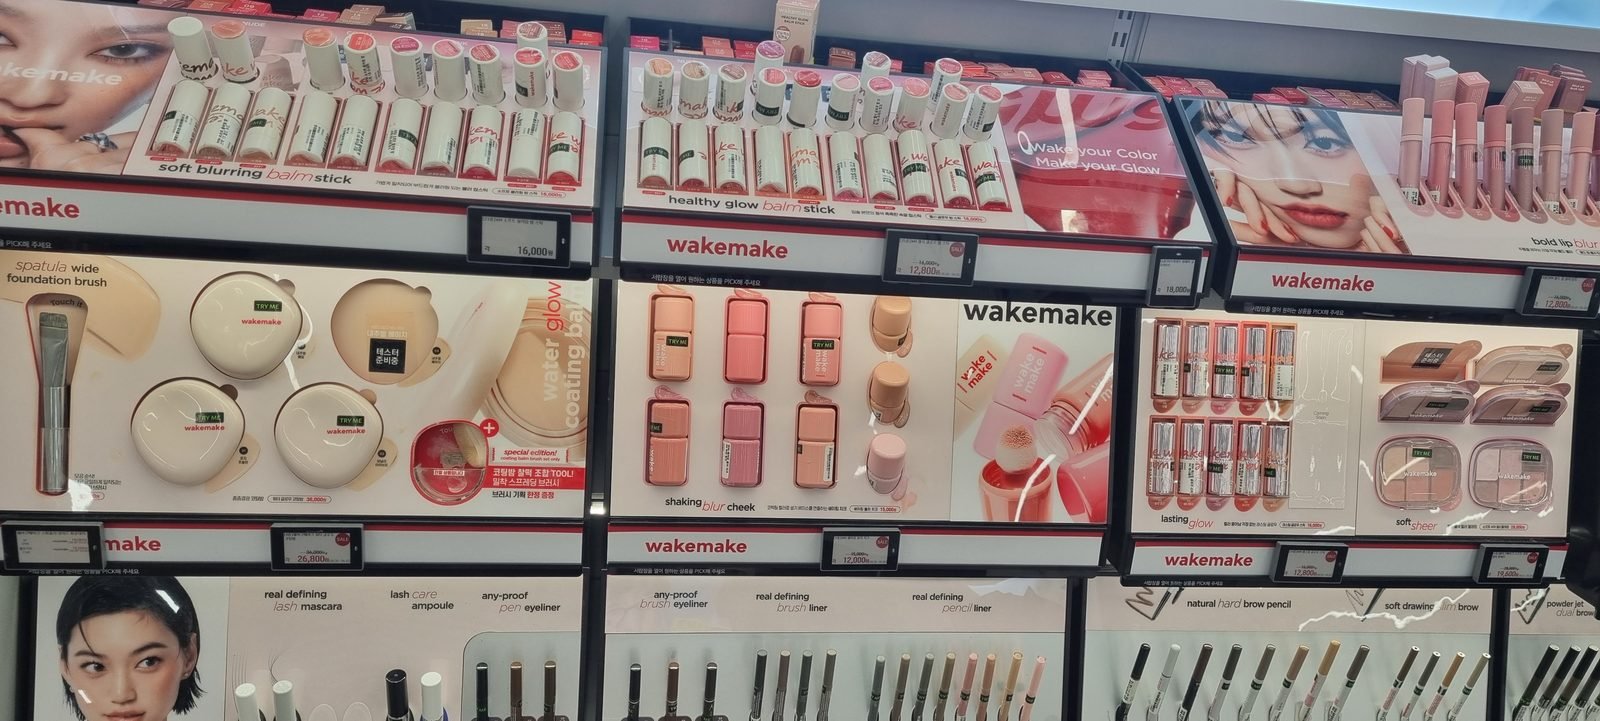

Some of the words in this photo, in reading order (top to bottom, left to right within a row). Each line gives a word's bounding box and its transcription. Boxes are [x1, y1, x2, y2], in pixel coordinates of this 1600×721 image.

[1077, 148, 1112, 158] your
[1117, 148, 1158, 161] Color
[1036, 157, 1076, 168] Make
[1081, 161, 1117, 172] your
[1121, 162, 1160, 175] Glow
[158, 162, 192, 174] soft
[196, 164, 263, 180] blurring
[266, 168, 313, 182] balm
[314, 172, 352, 185] stick
[668, 195, 720, 209] healthy
[725, 198, 759, 211] glow
[762, 200, 802, 213] balm
[803, 203, 836, 215] stick
[667, 236, 788, 259] wakemake
[1531, 237, 1558, 246] bold
[1558, 238, 1573, 248] lip
[1574, 237, 1598, 249] blur
[15, 259, 67, 273] spatula
[71, 263, 100, 274] wide
[7, 273, 71, 286] foundation
[74, 276, 108, 288] brush
[1271, 271, 1375, 292] wakemake
[542, 281, 564, 332] glow
[963, 300, 1113, 327] wakemake
[241, 318, 282, 326] wakemake
[668, 338, 679, 346] TRY
[376, 347, 399, 357] 테스터
[375, 356, 399, 365] 준비중
[543, 337, 560, 402] water
[967, 361, 993, 389] make
[1013, 352, 1035, 389] wake
[1025, 357, 1045, 394] make
[564, 344, 586, 430] coating
[184, 424, 225, 432] wakemake
[503, 449, 530, 457] special
[530, 449, 558, 457] edition!
[493, 467, 516, 477] 코팅밤
[517, 468, 532, 477] 찰떡
[534, 468, 549, 477] 조합
[551, 470, 574, 478] TOOL!
[492, 478, 507, 486] 밀착
[508, 479, 537, 487] 스프레딩
[538, 479, 560, 487] 브러시
[492, 490, 512, 499] 브러시
[513, 491, 526, 499] 기획
[527, 491, 540, 499] 한정
[541, 491, 555, 499] 증정
[665, 497, 702, 508] shaking
[702, 500, 725, 512] blur
[727, 503, 756, 512] cheek
[1161, 514, 1189, 524] lasting
[1188, 519, 1214, 530] glow
[1396, 517, 1411, 526] soft
[1411, 520, 1438, 531] sheer
[645, 539, 747, 554] wakemake
[1165, 552, 1253, 567] wakemake
[264, 590, 283, 599] real
[286, 590, 327, 602] defining
[390, 590, 410, 599] lash
[412, 590, 437, 599] care
[482, 590, 528, 602] any-proof
[653, 590, 698, 600] any-proof
[756, 592, 773, 601] real
[774, 592, 809, 602] defining
[912, 592, 928, 601] real
[929, 592, 963, 602] defining
[273, 601, 298, 612] lash
[300, 602, 343, 611] mascara
[411, 602, 454, 612] ampoule
[499, 603, 522, 613] pen
[524, 602, 561, 613] eyeliner
[640, 599, 671, 609] brush
[673, 600, 708, 609] eyeliner
[777, 602, 807, 612] brush
[808, 603, 828, 612] liner
[942, 602, 973, 613] pencil
[973, 604, 992, 612] liner
[1187, 599, 1216, 608] natural
[1218, 599, 1242, 608] hard
[1243, 599, 1265, 608] brow
[1266, 599, 1292, 609] pencil
[1385, 601, 1401, 610] soft
[1402, 602, 1434, 612] drawing
[1458, 602, 1479, 611] brow
[1546, 600, 1574, 608] powder
[1575, 600, 1584, 608] jet
[1555, 608, 1575, 617] dual
